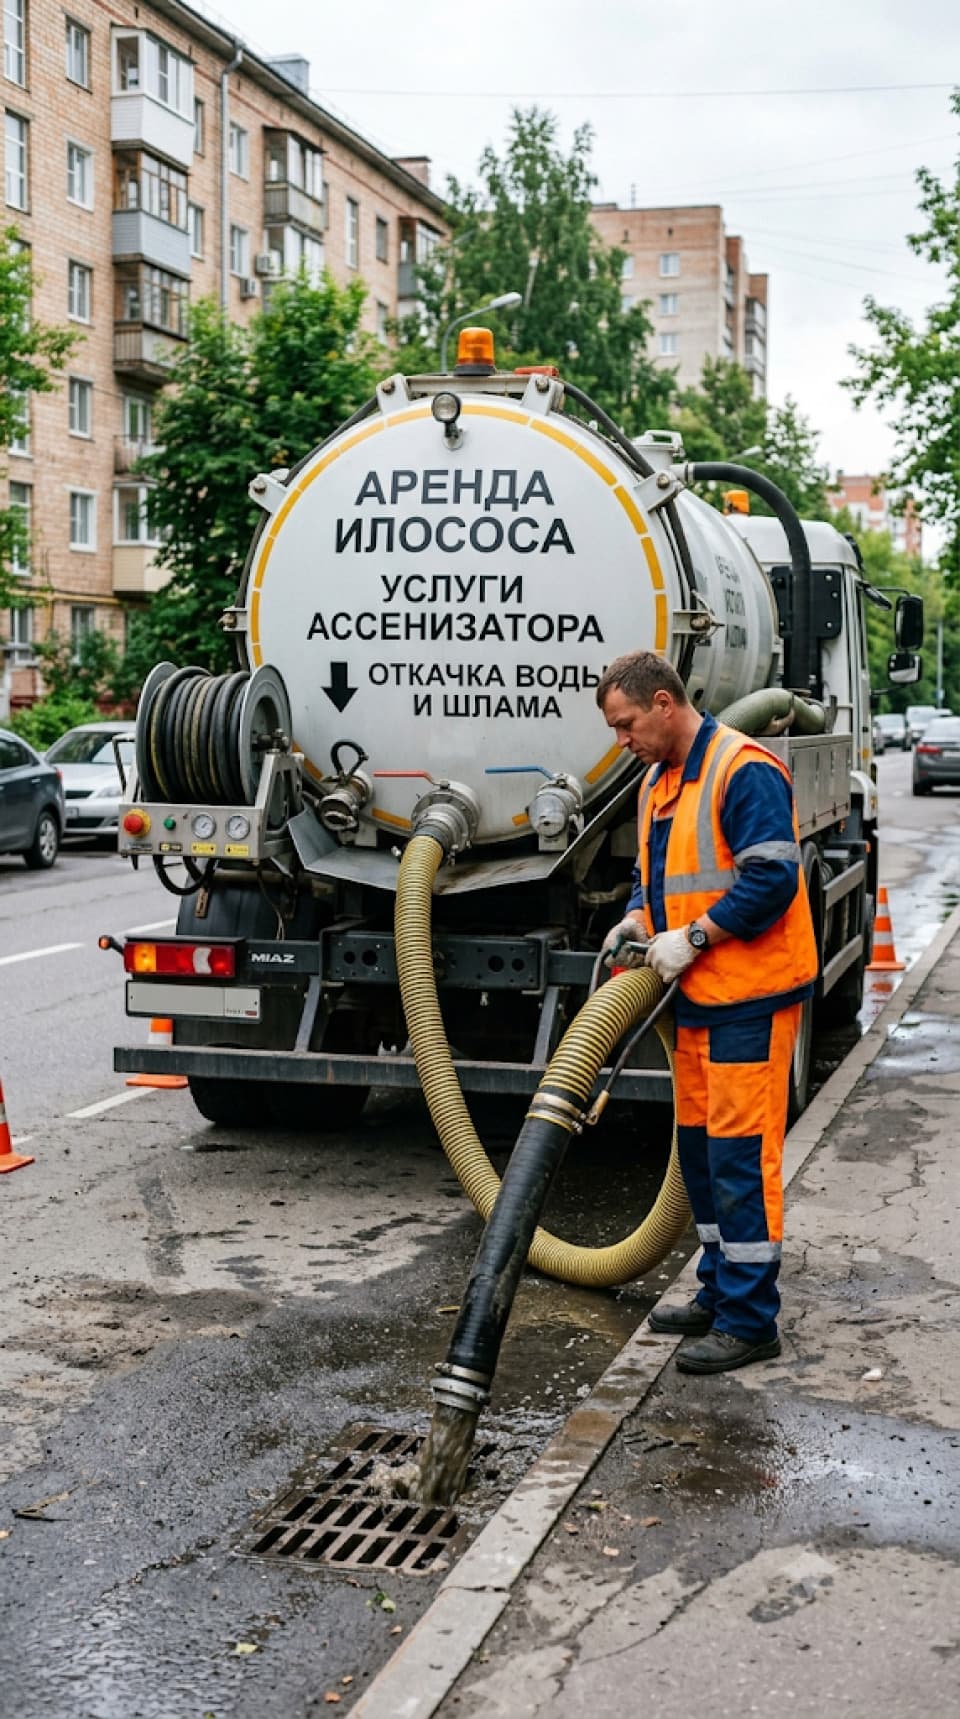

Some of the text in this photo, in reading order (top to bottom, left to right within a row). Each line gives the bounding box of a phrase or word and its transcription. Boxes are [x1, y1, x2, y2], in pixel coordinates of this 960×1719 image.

[355, 469, 555, 512] АРЕНДА
[335, 516, 576, 555] ИЛОСОСА
[381, 573, 523, 604] УСЛУГИ
[306, 611, 605, 643] АССЕНИЗАТОРА
[368, 662, 502, 688] ОТКАЧКА
[413, 693, 563, 719] И ШЛАМА
[251, 953, 296, 963] MIAZ
